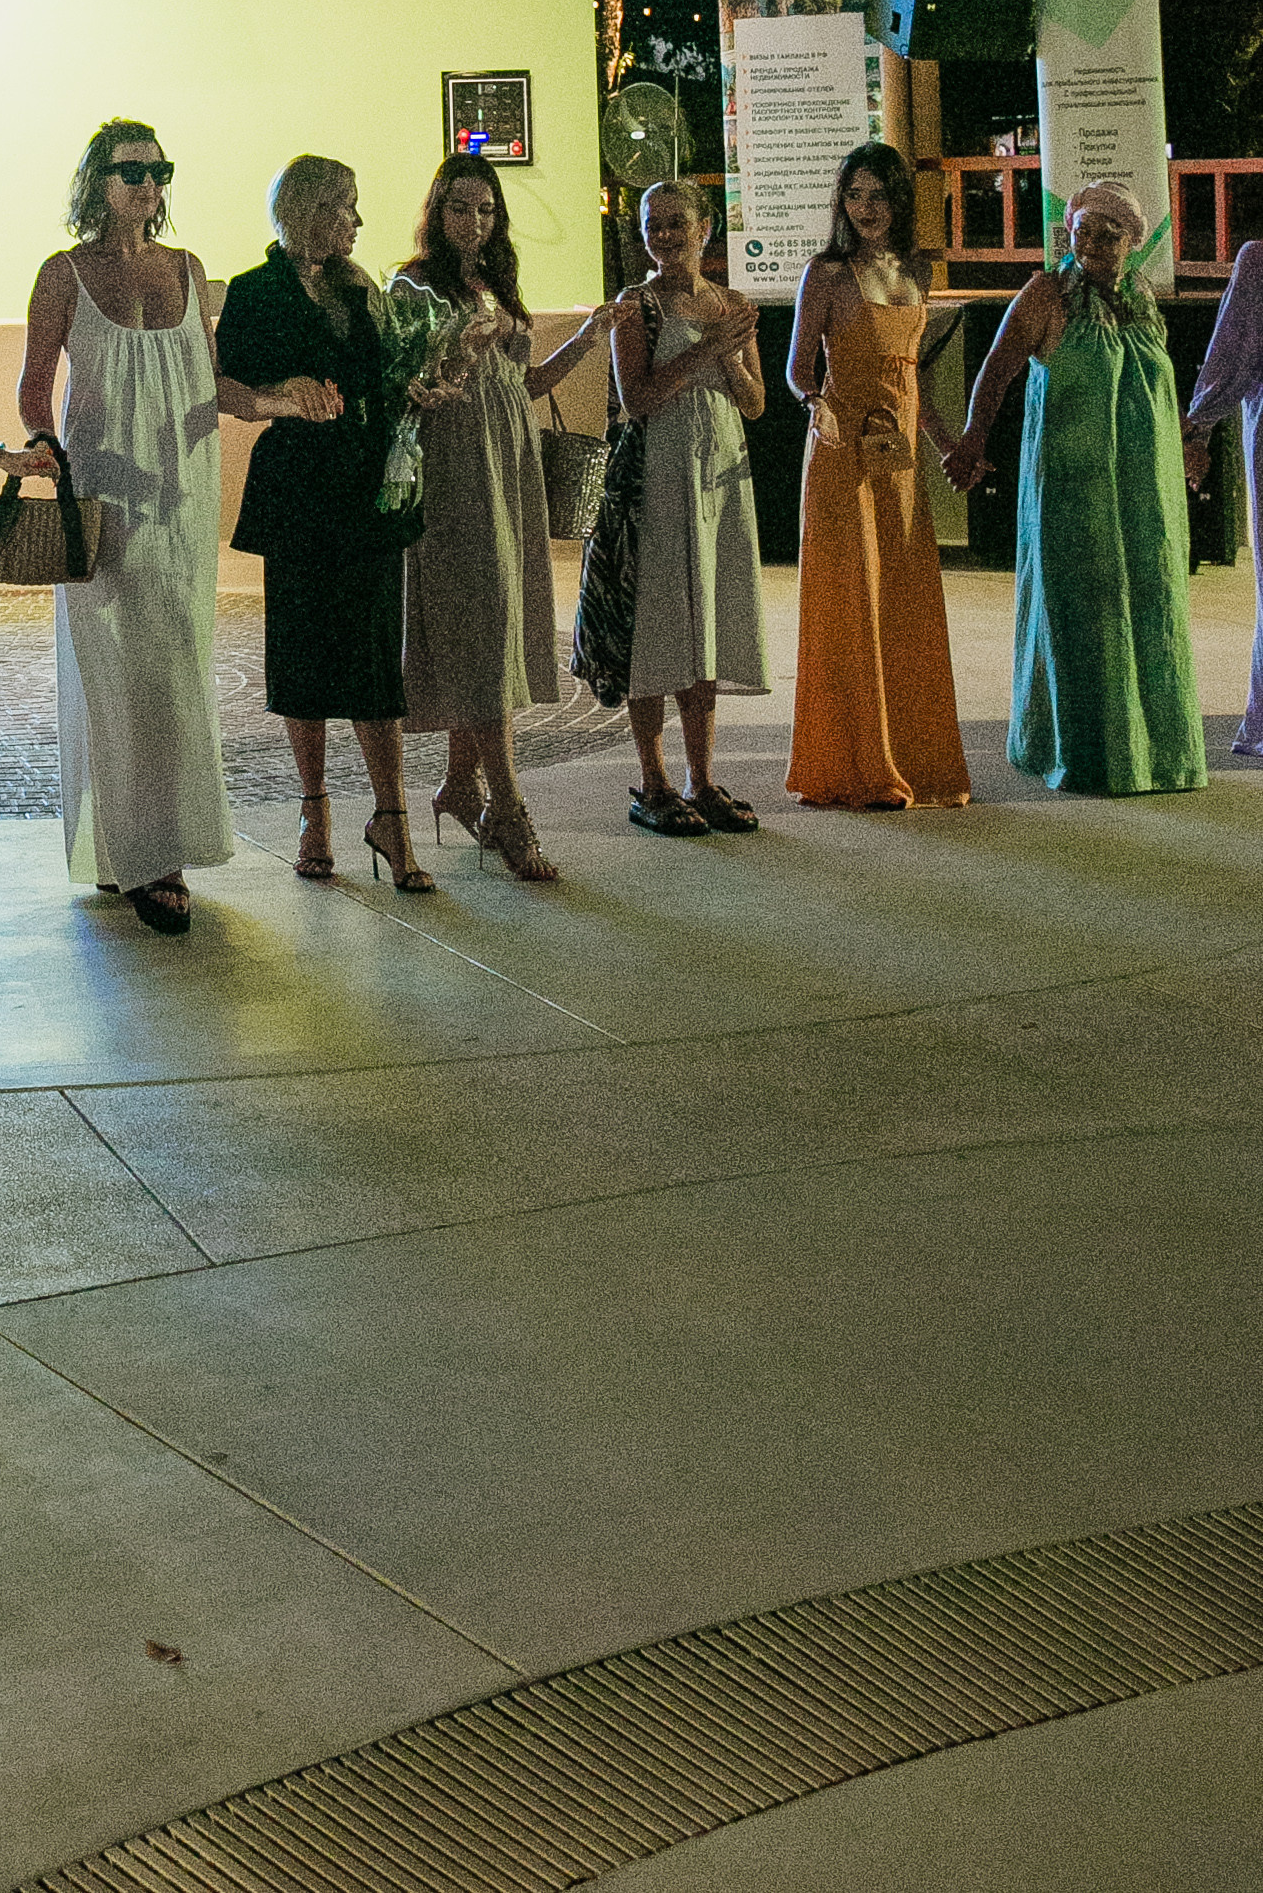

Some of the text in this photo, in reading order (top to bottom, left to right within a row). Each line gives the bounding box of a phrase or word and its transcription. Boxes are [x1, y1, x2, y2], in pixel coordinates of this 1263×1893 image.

[784, 66, 820, 74] ПРОДАЖА
[750, 74, 810, 82] НЕДВИЖИМОСТИ
[1079, 127, 1118, 138] Продажа
[1080, 142, 1116, 152] Покупка
[1080, 156, 1112, 167] Аренда
[1080, 170, 1134, 181] Управление
[798, 182, 834, 190] КАТАМАР
[768, 238, 785, 248] +66
[786, 239, 798, 247] 85
[768, 249, 785, 258] +66
[753, 274, 800, 282] www.tour
